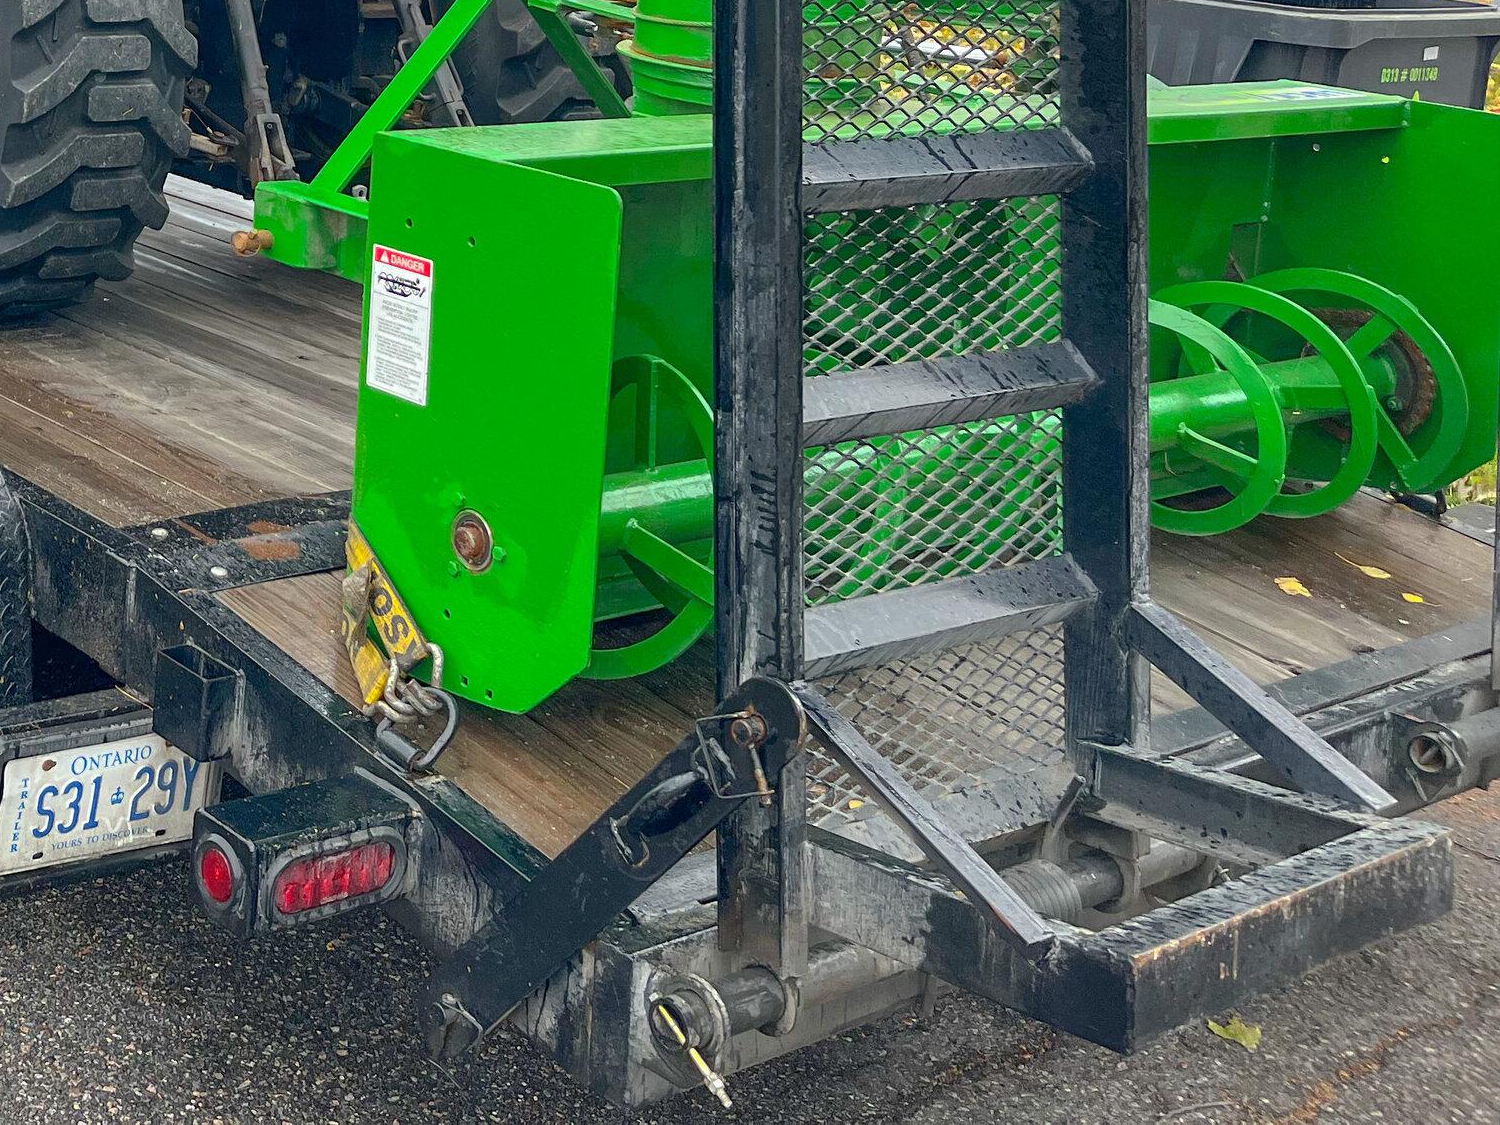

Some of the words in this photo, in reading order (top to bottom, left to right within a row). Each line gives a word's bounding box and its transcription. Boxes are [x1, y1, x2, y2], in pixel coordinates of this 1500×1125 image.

[390, 254, 425, 273] DANGER
[71, 745, 152, 775] ONTARIO
[32, 774, 104, 839] S31
[129, 755, 200, 822] 29Y
[10, 778, 29, 852] TRAILER
[51, 838, 83, 851] YOURS
[86, 834, 99, 845] TO
[102, 825, 148, 841] DISCOVER
